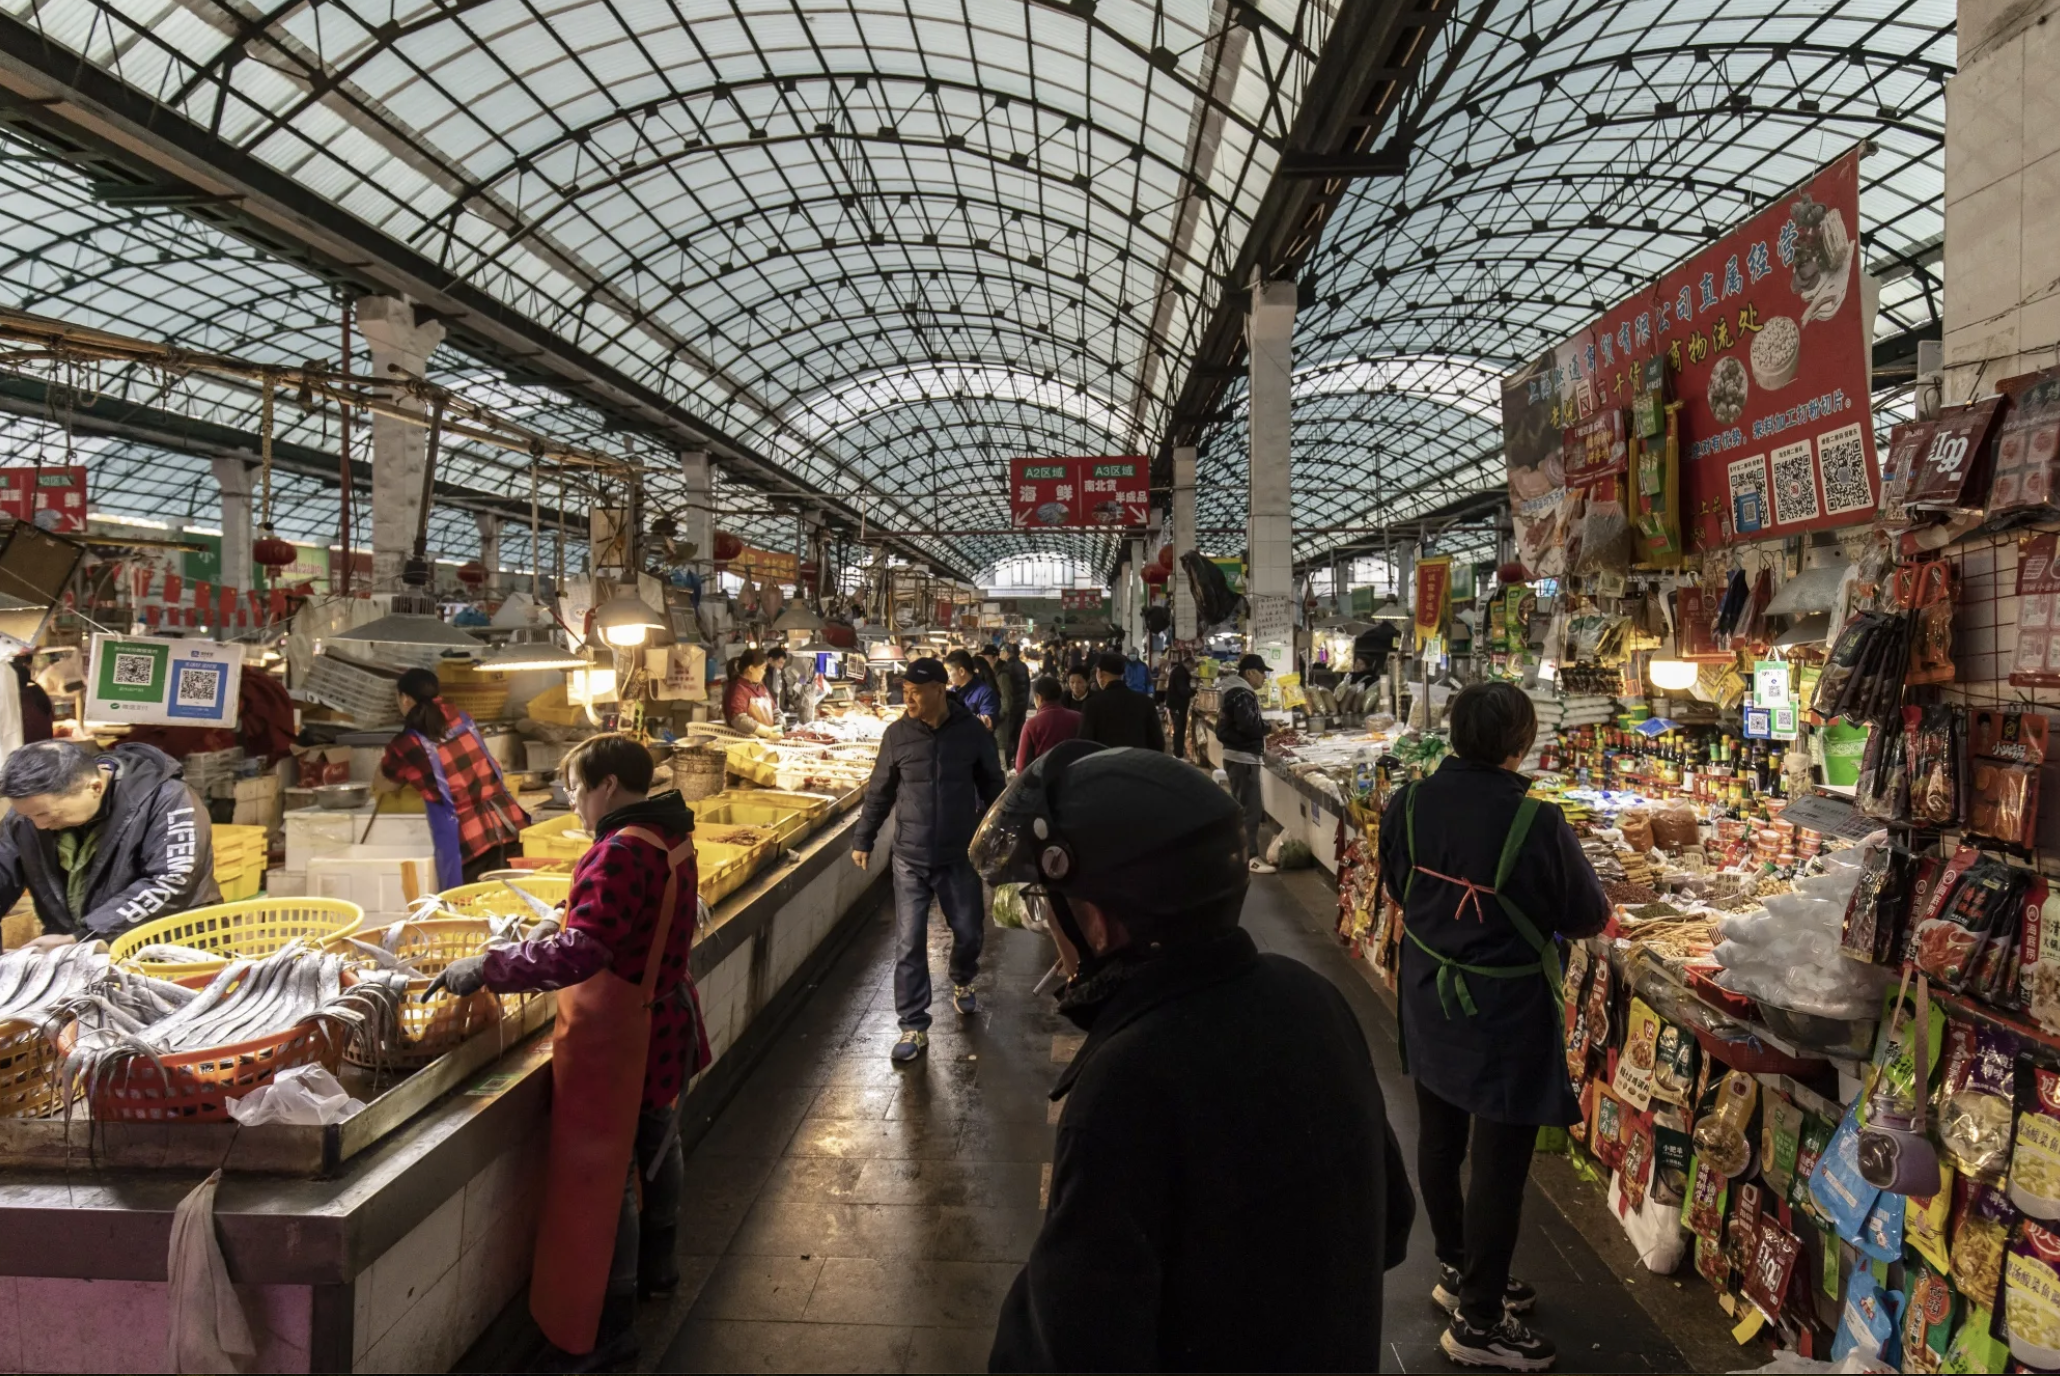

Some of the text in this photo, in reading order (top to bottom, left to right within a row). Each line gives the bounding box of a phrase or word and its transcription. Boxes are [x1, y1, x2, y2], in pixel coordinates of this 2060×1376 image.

[1025, 467, 1064, 478] A2区域
[1095, 465, 1134, 477] A3区域
[1084, 479, 1117, 492] 南北货
[1019, 484, 1073, 502] 海鲜
[1115, 490, 1147, 503] 半成品
[1992, 741, 2027, 760] 小火锅
[2026, 923, 2037, 960] 海底捞
[1662, 1144, 1683, 1154] 小肥羊
